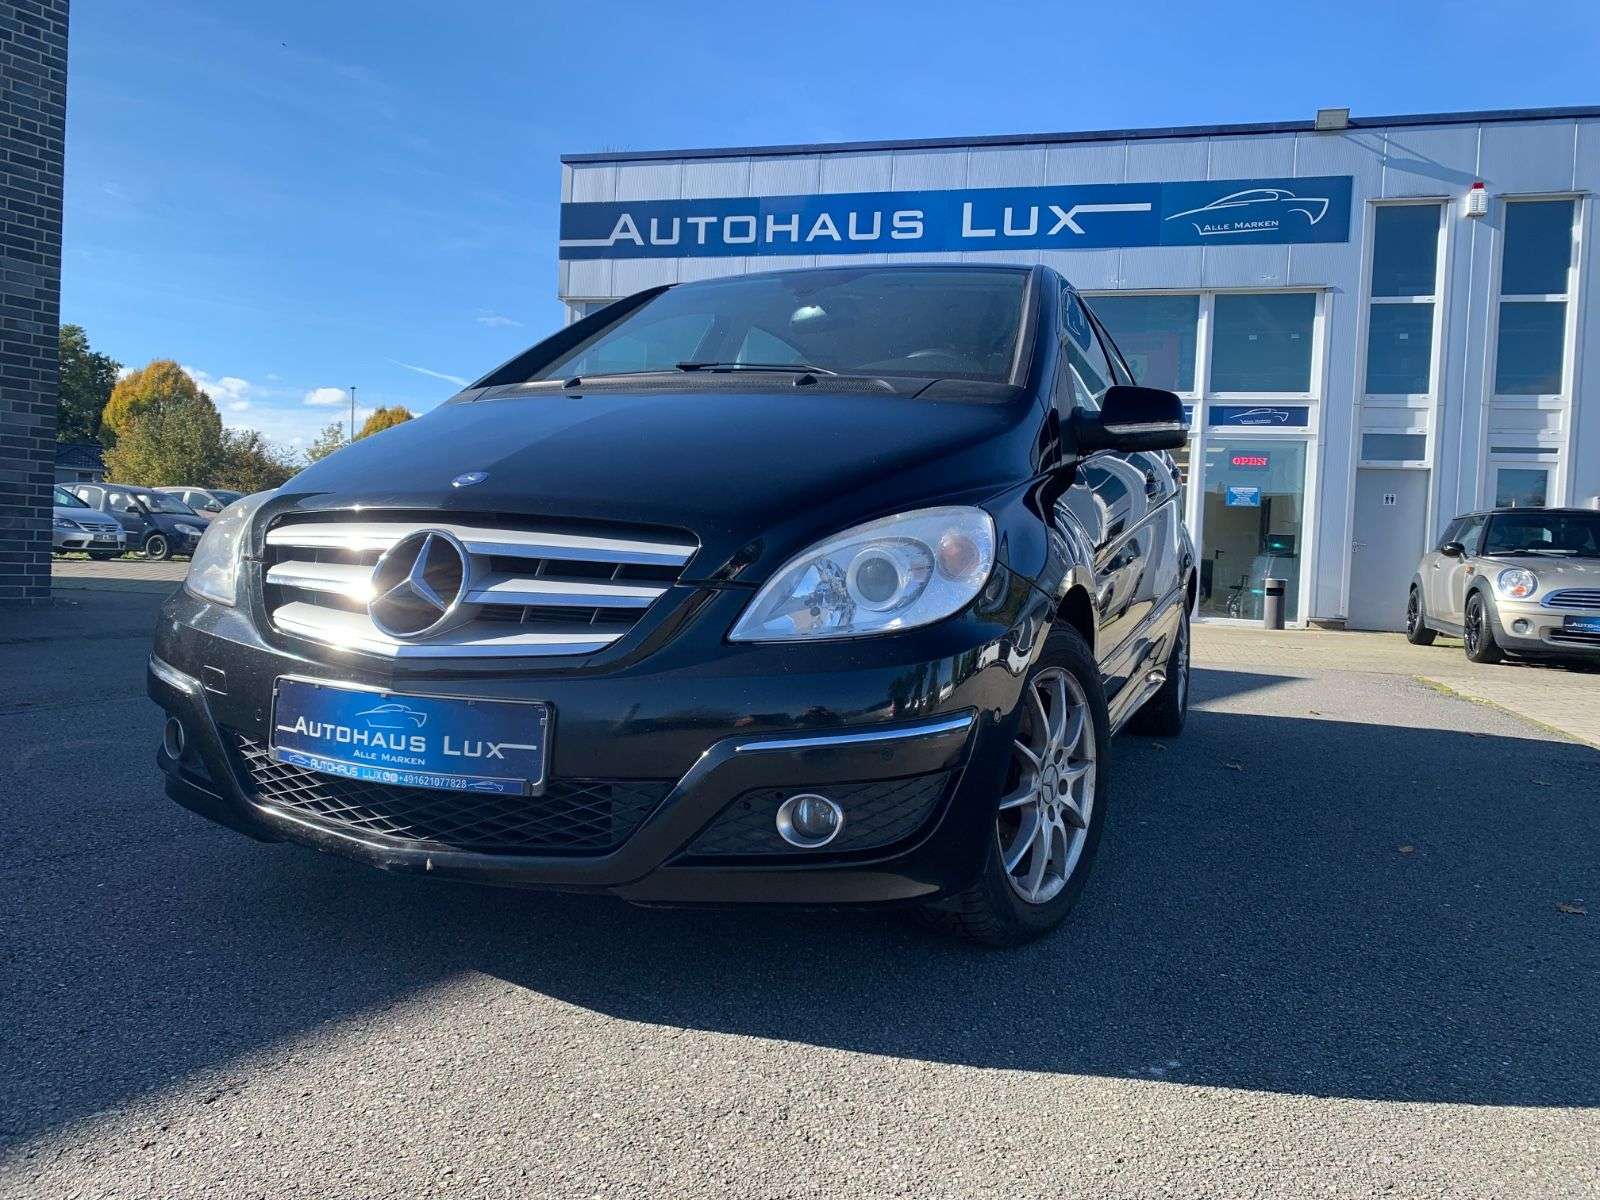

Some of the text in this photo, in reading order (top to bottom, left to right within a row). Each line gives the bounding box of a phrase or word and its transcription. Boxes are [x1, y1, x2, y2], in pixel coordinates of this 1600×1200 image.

[608, 202, 1086, 246] AUTOHAUS LUX
[1203, 220, 1279, 232] ALLE MARKEN
[1232, 457, 1268, 466] OPEN
[295, 716, 505, 760] AUTOHAUS LUX
[353, 749, 426, 766] ALLE MARKEN
[310, 758, 358, 777] AUTOHAUS
[362, 766, 381, 781] LUX
